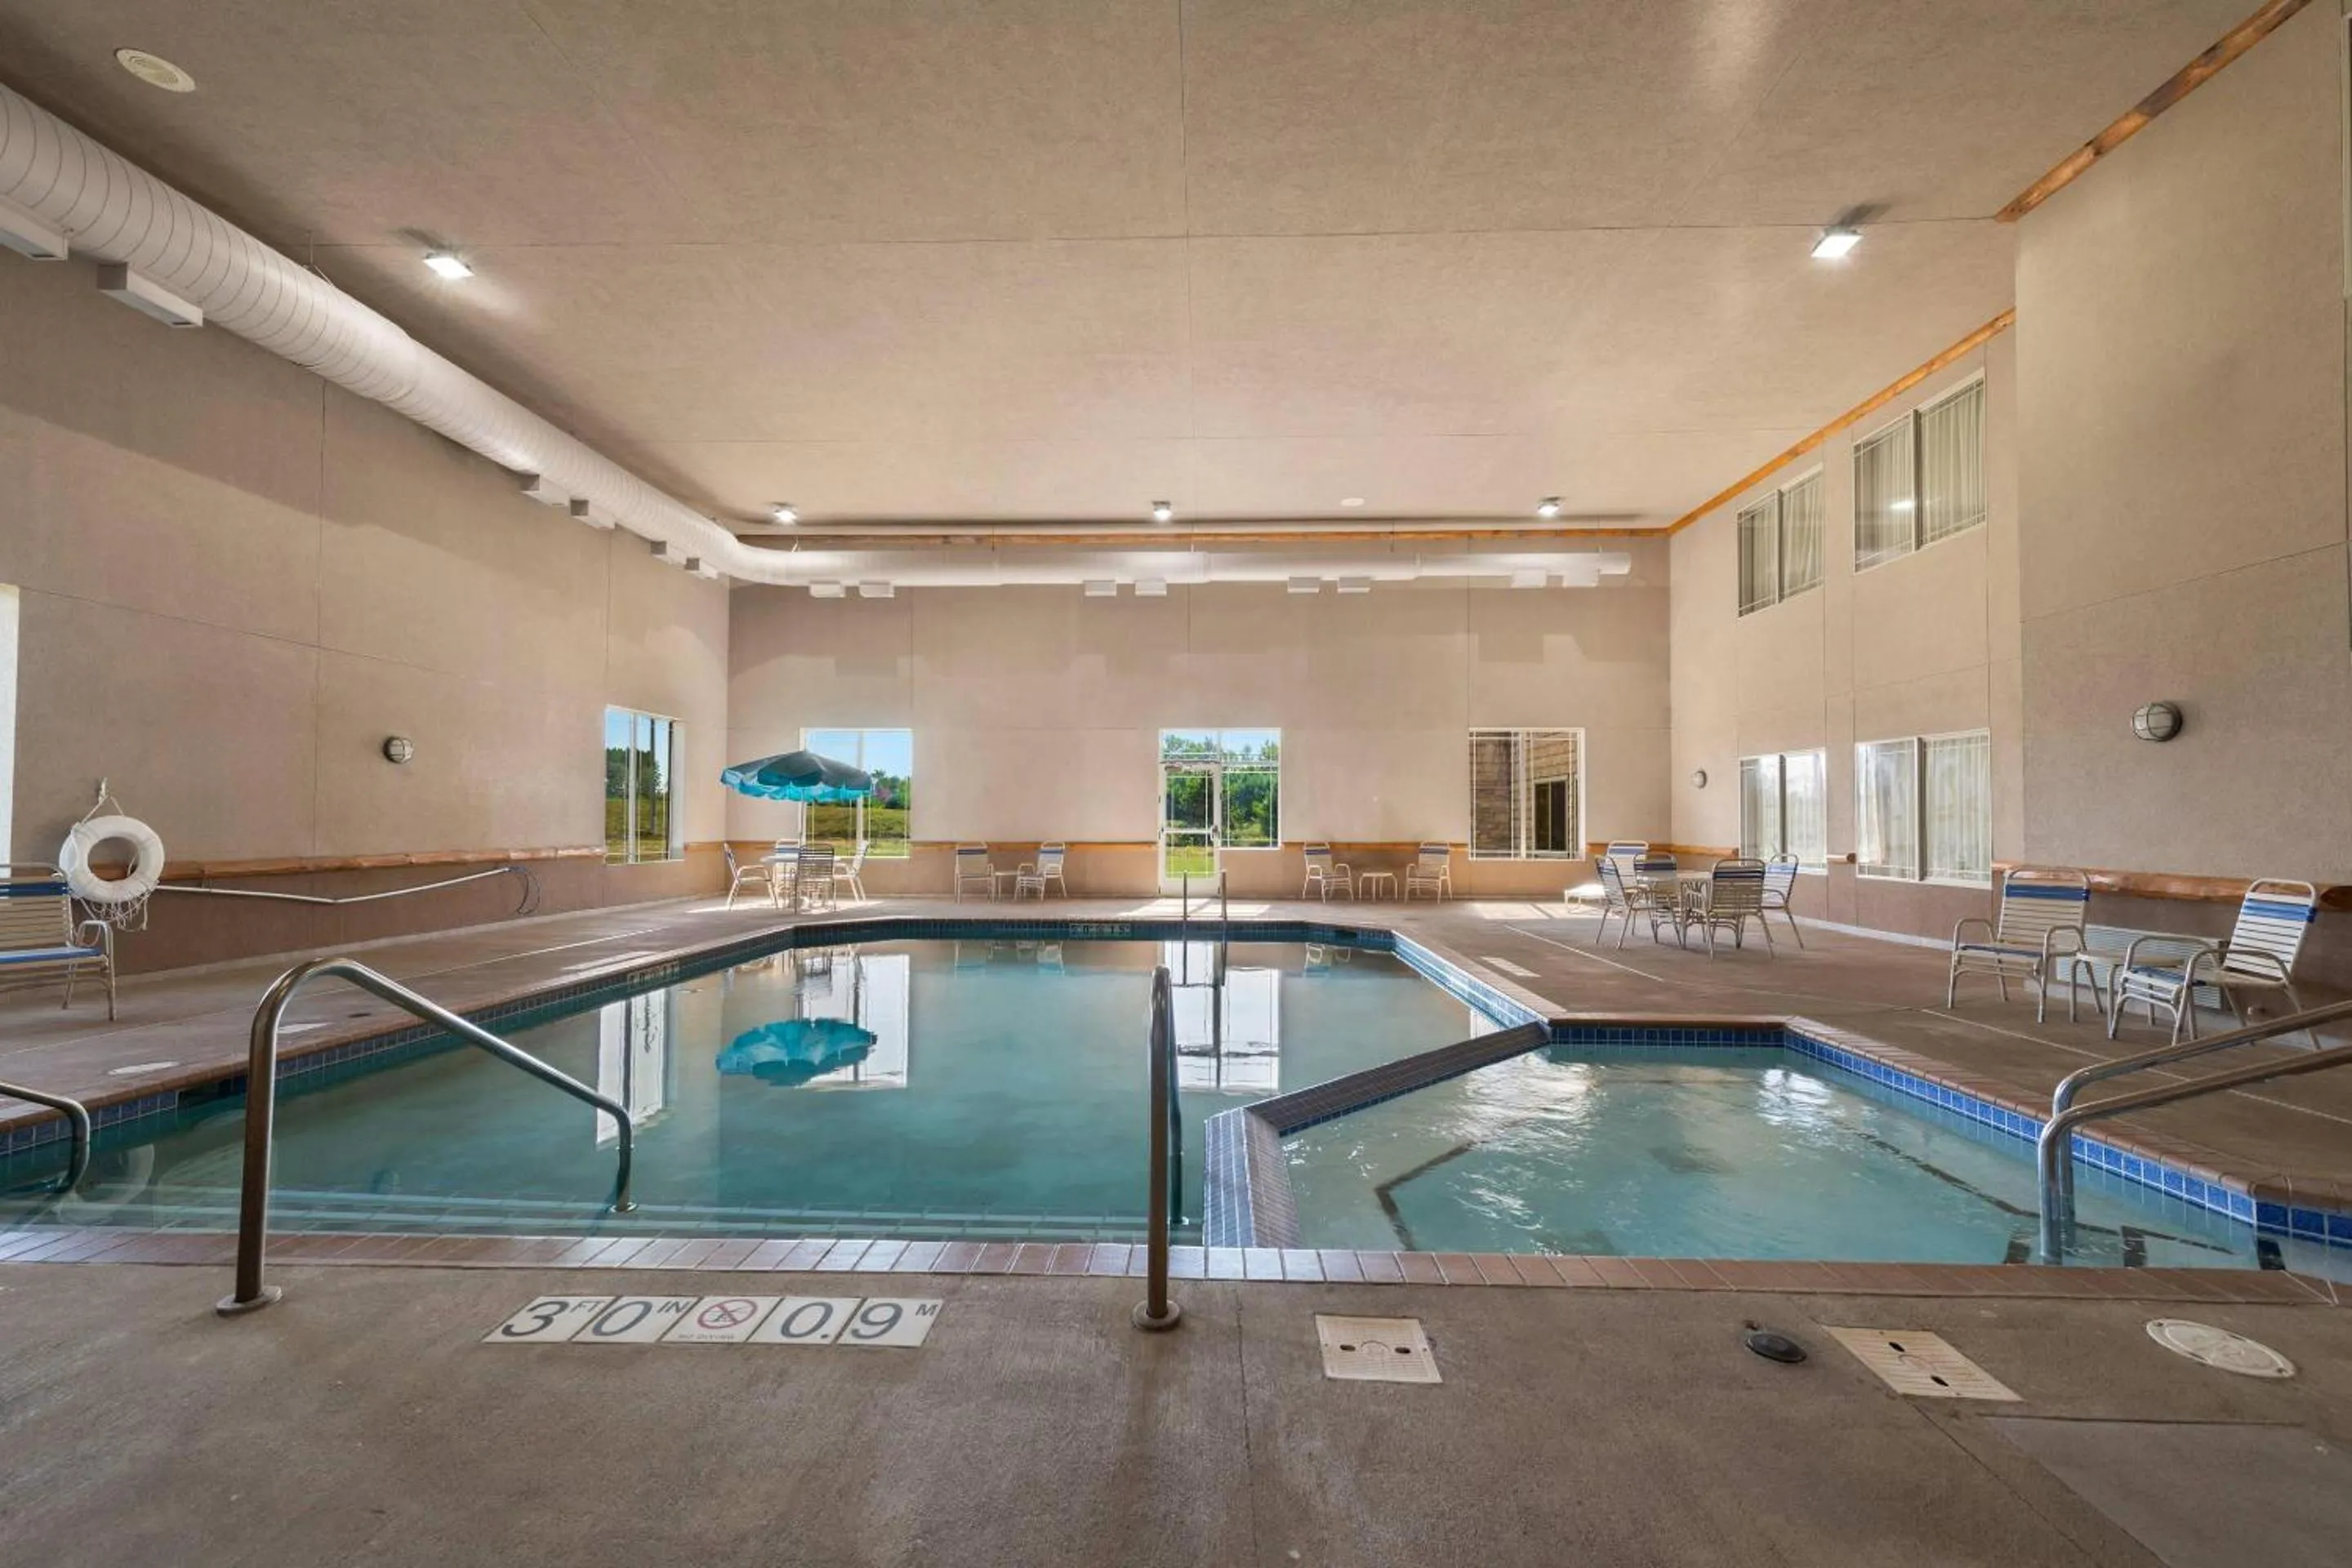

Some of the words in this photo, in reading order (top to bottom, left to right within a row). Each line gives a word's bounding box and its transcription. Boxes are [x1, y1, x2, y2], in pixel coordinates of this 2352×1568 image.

[501, 1301, 570, 1337] 3
[570, 1300, 607, 1312] FT
[657, 1301, 689, 1313] IN
[915, 1304, 938, 1316] M
